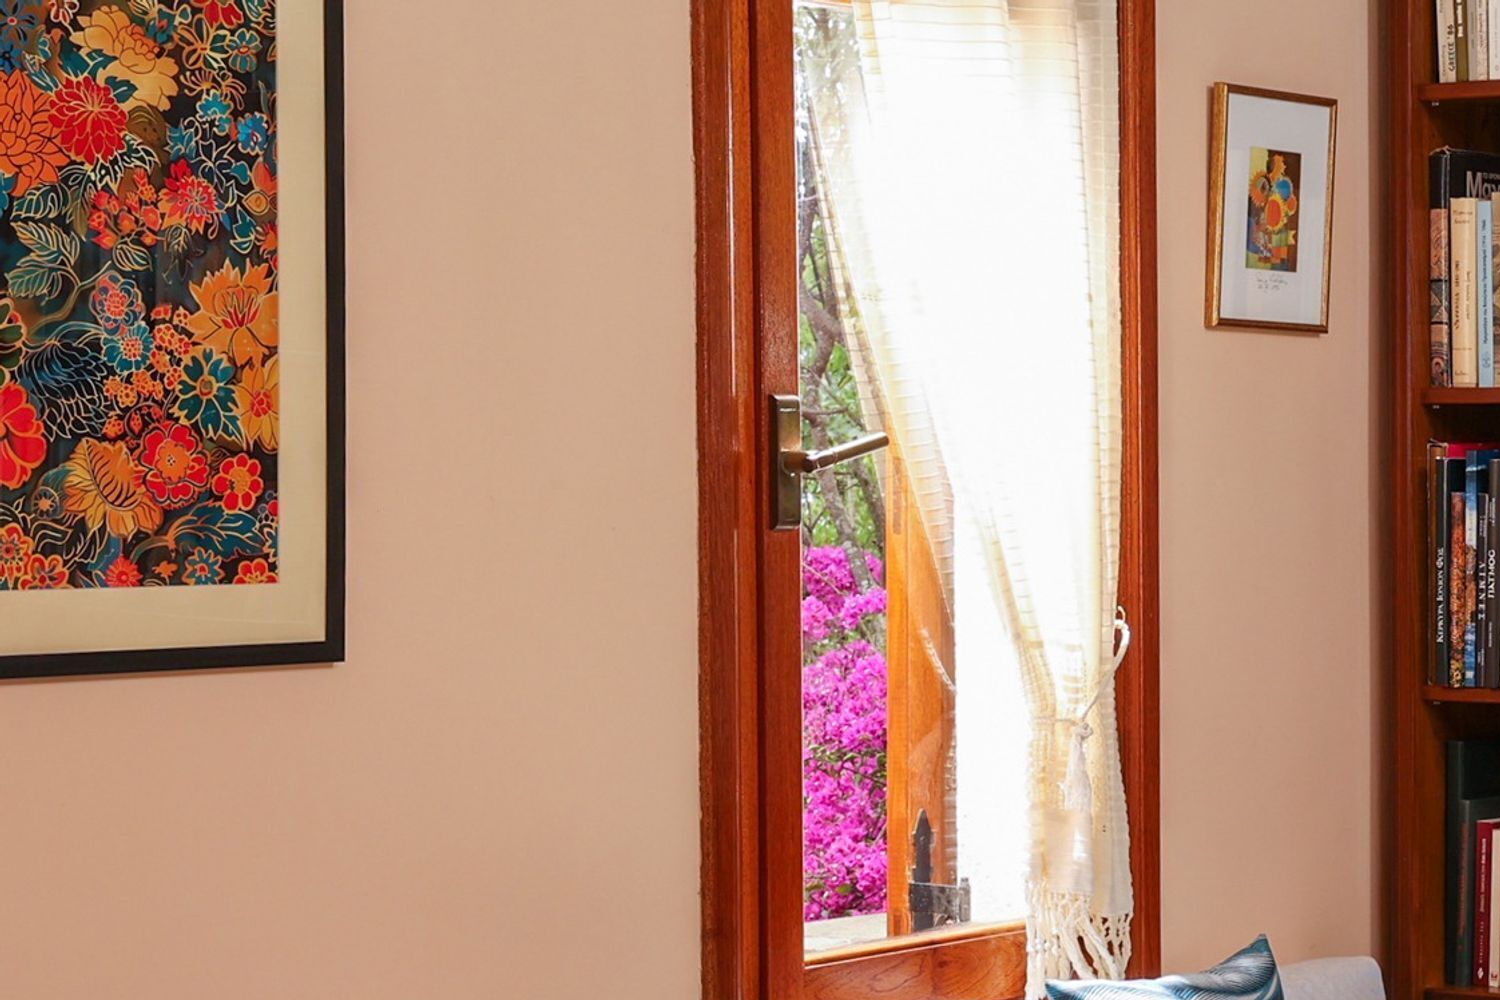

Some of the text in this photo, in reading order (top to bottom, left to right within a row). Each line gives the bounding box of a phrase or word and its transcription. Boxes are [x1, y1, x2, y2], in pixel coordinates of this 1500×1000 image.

[1436, 570, 1444, 601] ΙΟΝΙΟΝ
[1478, 561, 1487, 620] ΛΙΜΝΕΣ
[1436, 604, 1444, 643] ΚΕΡΚΥΡΑ
